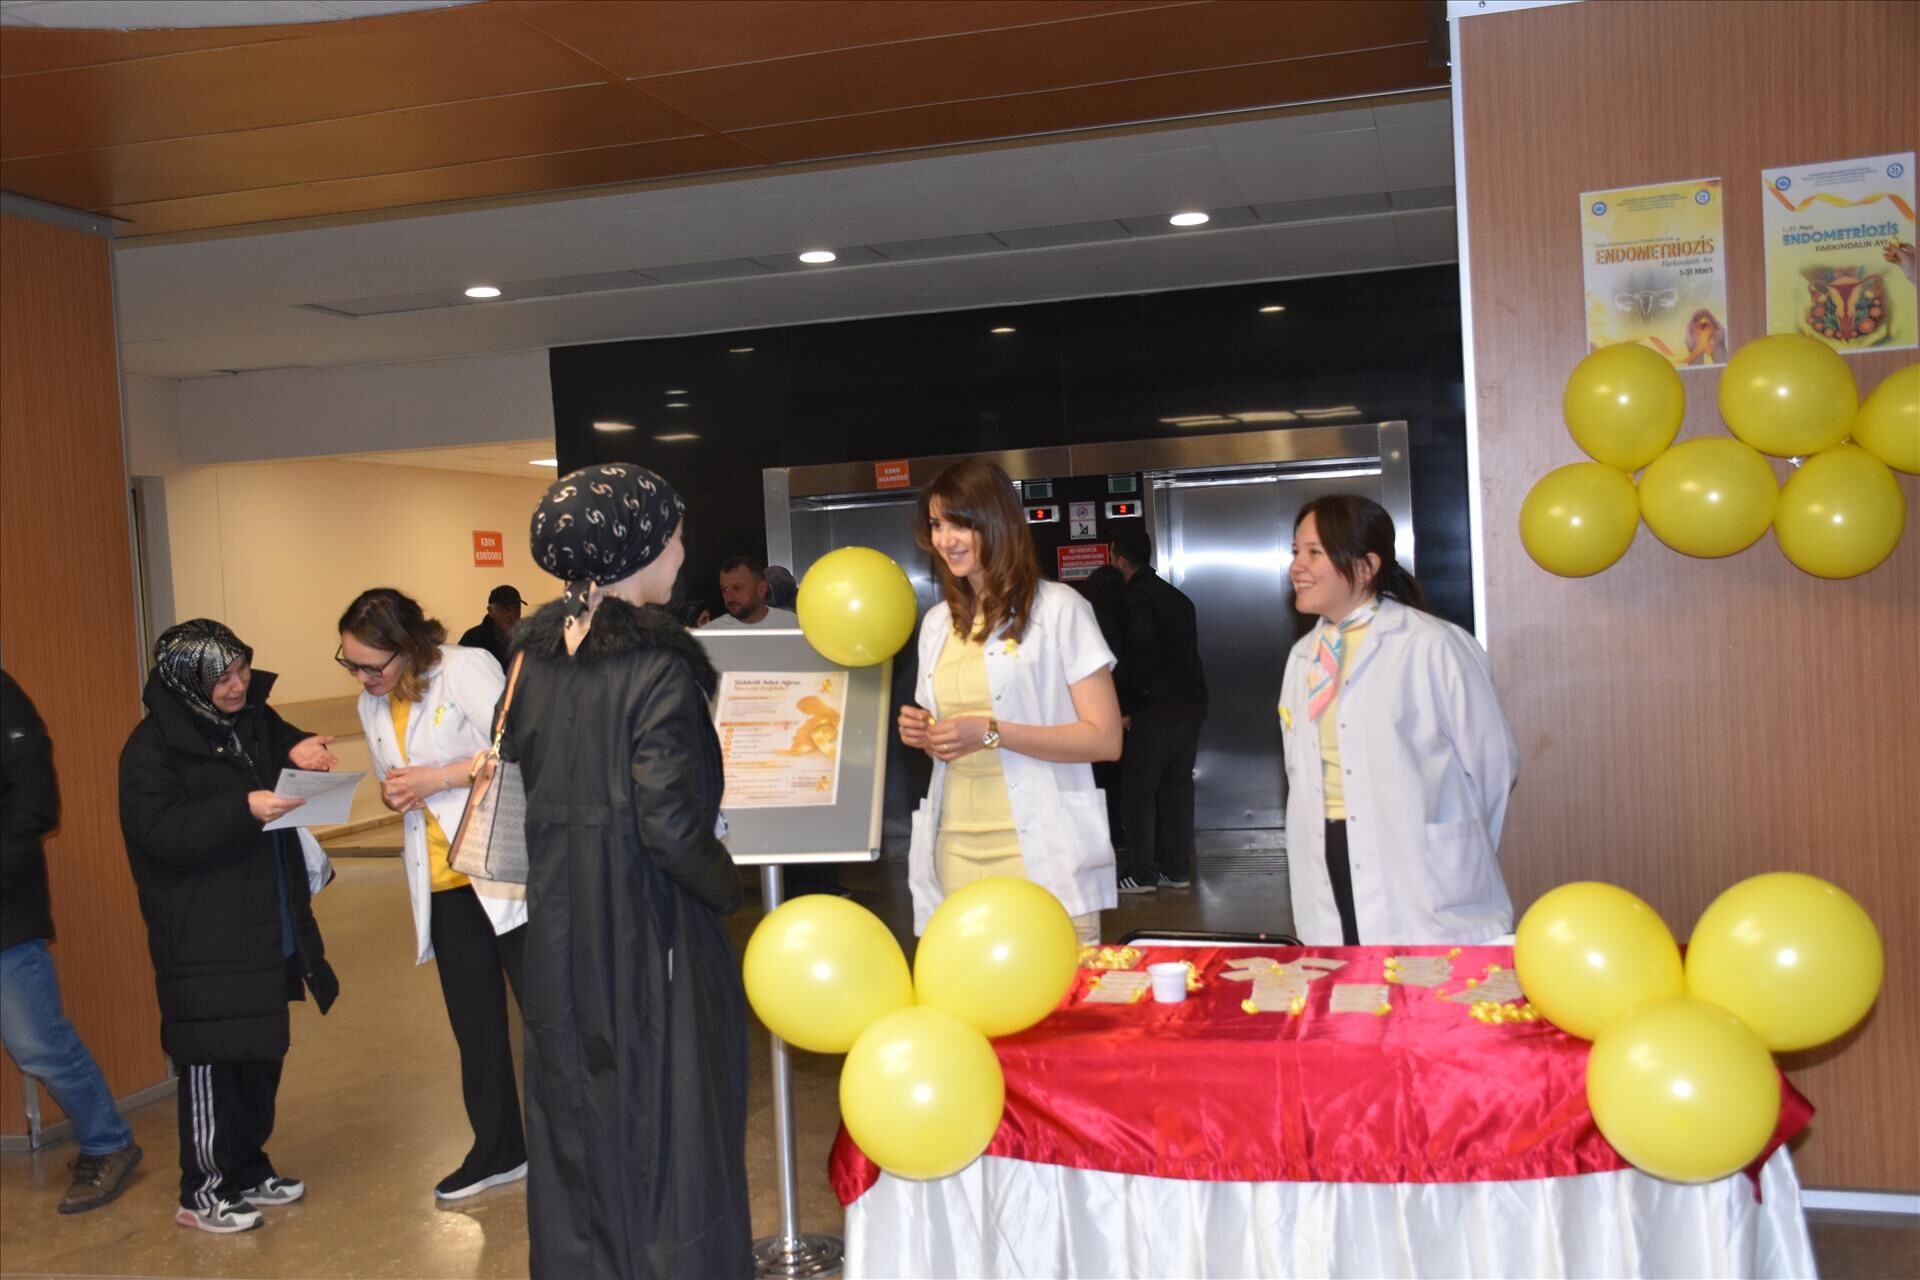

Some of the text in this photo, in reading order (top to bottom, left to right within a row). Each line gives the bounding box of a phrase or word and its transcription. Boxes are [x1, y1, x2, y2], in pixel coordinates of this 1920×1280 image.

[1782, 221, 1899, 246] ENDOMETRİOZİS
[1595, 235, 1714, 265] ENDOMETRİOZİS
[1815, 241, 1873, 252] FARKINDALIK
[1694, 266, 1713, 275] Mart
[1120, 504, 1127, 513] 2
[1036, 509, 1044, 519] 2
